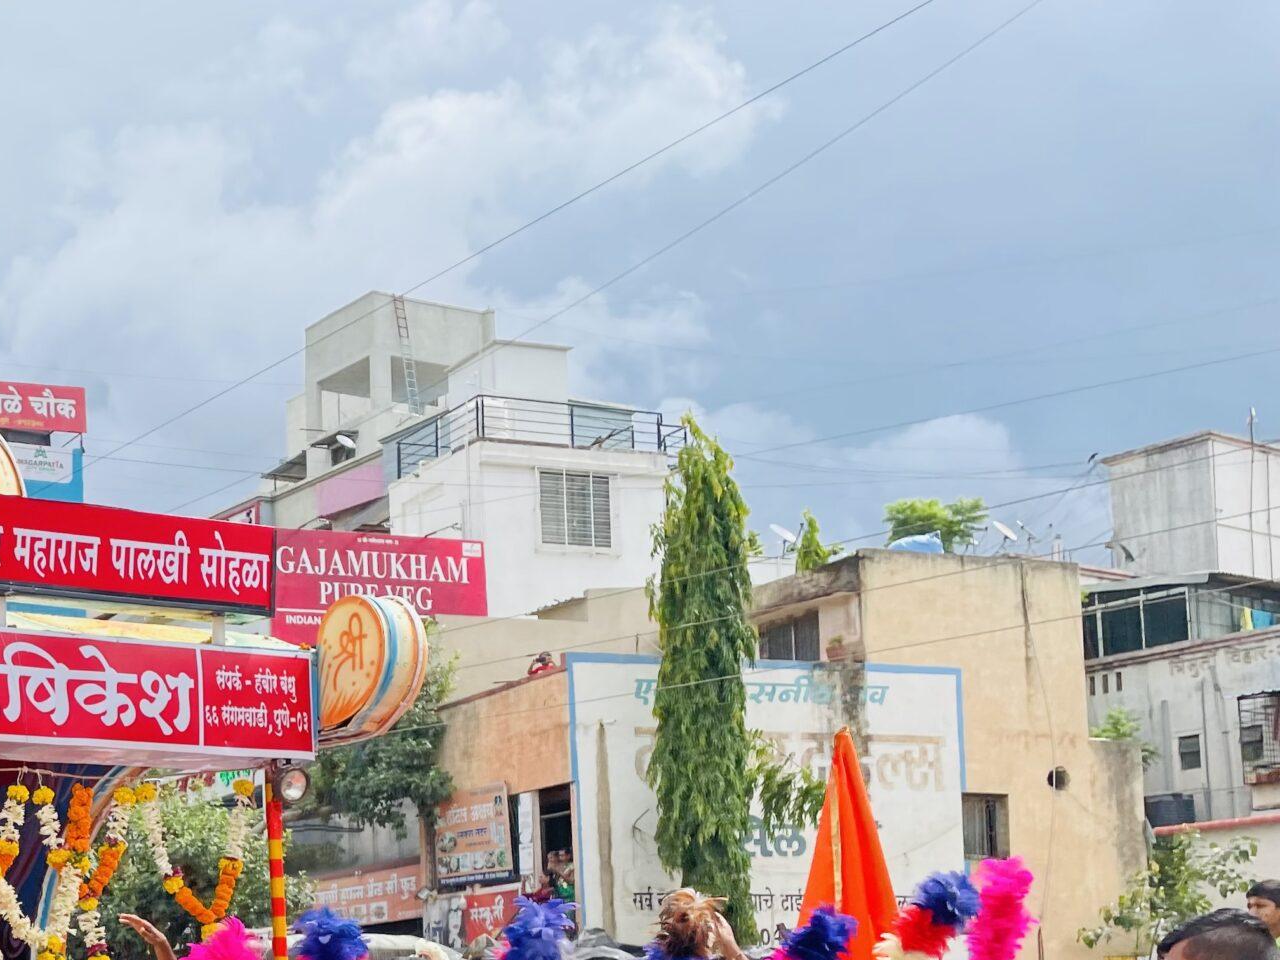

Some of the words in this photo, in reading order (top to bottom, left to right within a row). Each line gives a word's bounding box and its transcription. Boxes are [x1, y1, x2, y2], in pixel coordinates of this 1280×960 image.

[28, 388, 78, 419] चौक
[13, 527, 101, 578] महाराज
[109, 530, 191, 585] पालखी
[199, 531, 270, 595] सोहळा
[276, 545, 470, 585] GAJAMUKHAM
[385, 585, 434, 611] VEG
